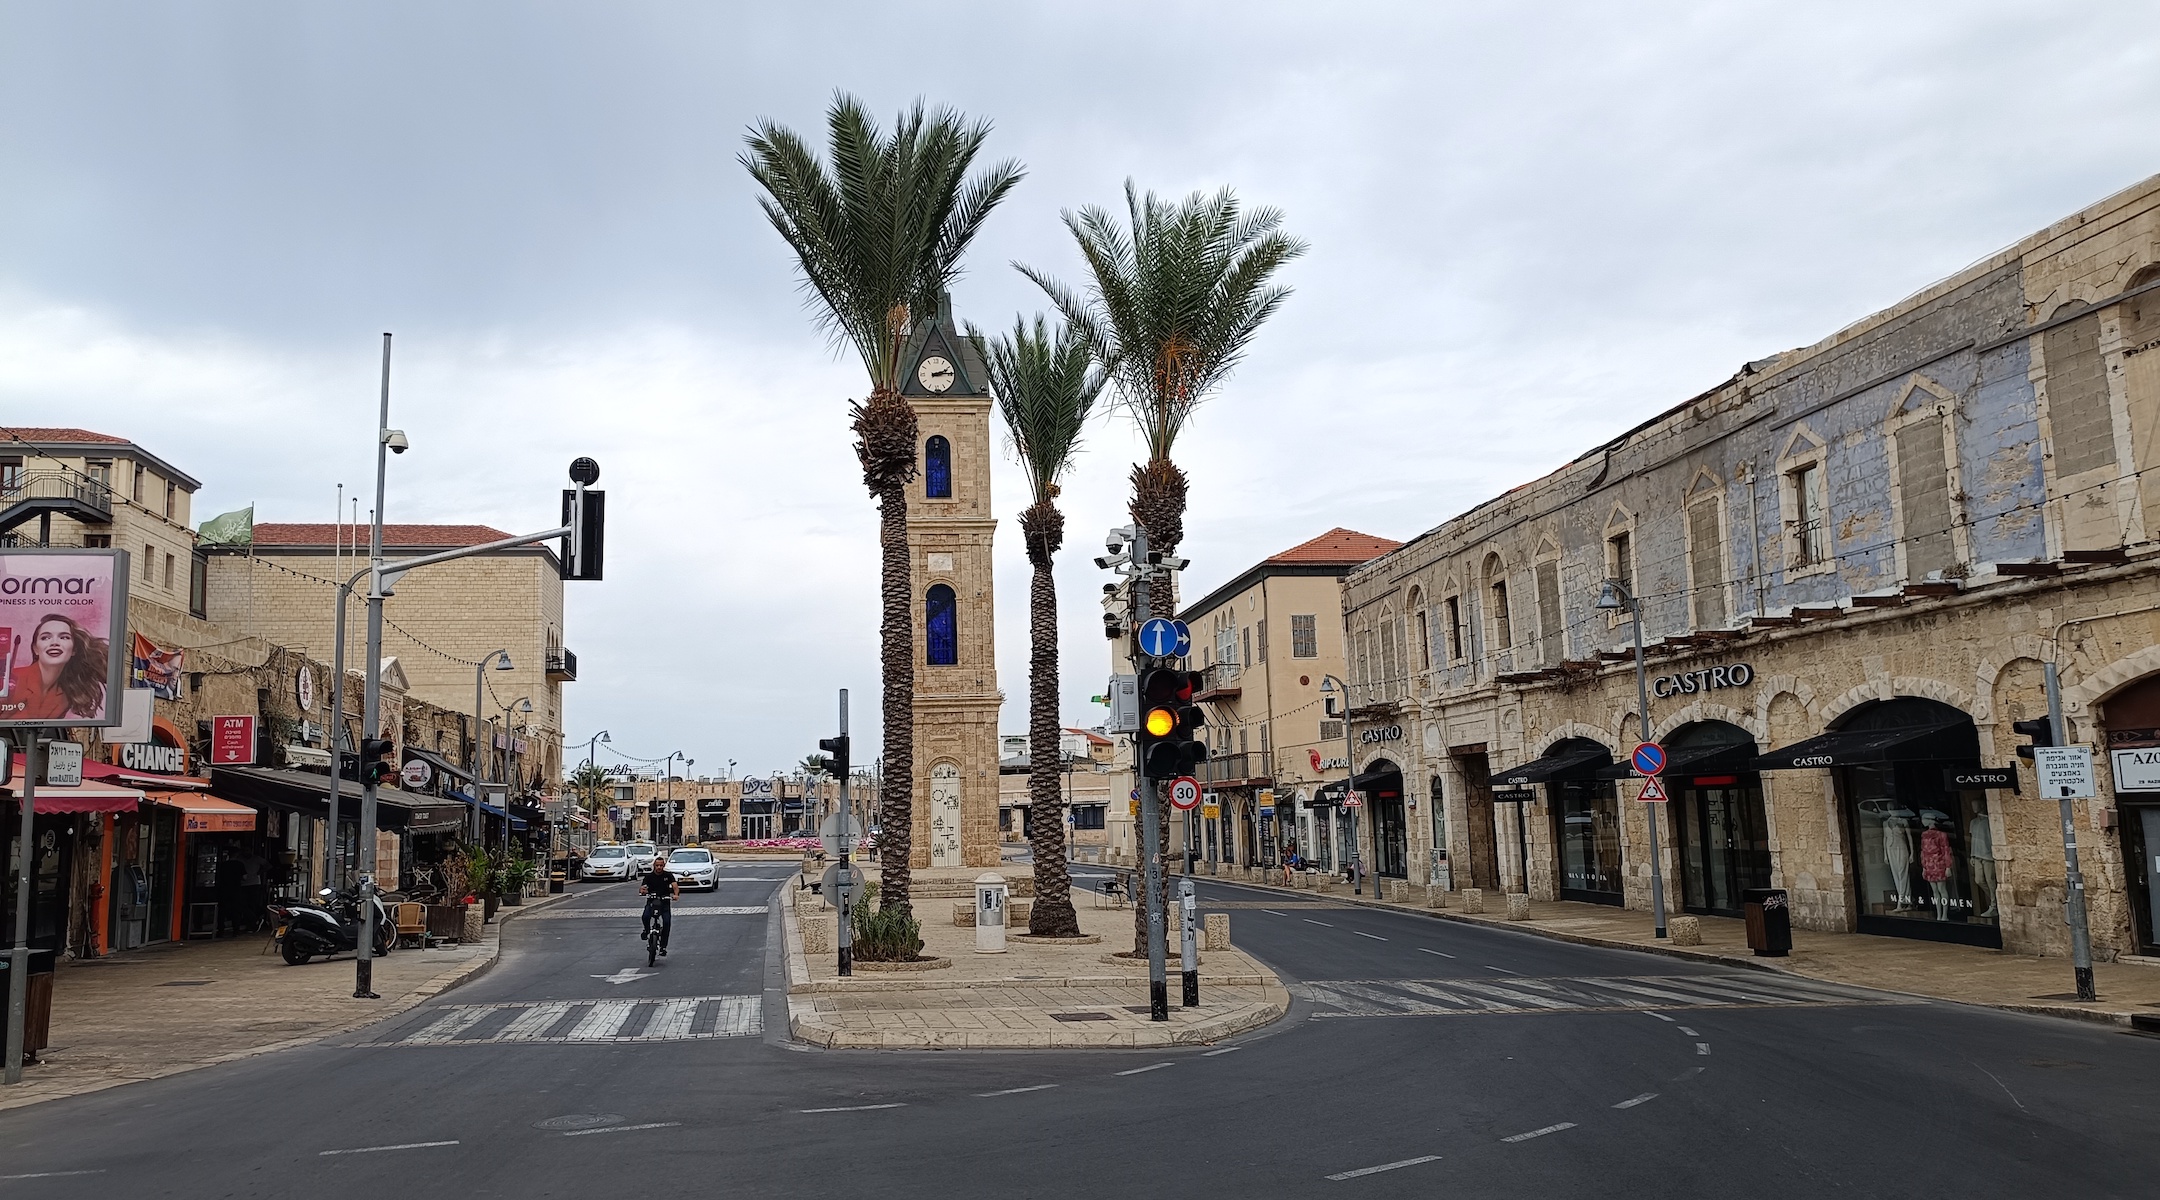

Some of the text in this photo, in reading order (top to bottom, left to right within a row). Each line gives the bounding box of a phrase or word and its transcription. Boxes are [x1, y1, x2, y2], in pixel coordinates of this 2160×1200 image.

[1652, 663, 1752, 698] CASTRO
[223, 719, 243, 728] ATM
[1360, 725, 1400, 743] CASTRO
[122, 742, 184, 771] CHANGE
[1793, 755, 1833, 767] CASTRO
[1320, 758, 1331, 769] RIP
[1508, 776, 1528, 784] CASTRO
[1956, 774, 2007, 783] CASTRO
[2048, 777, 2085, 785] אלקטרוניים
[1176, 787, 1194, 799] 30
[1890, 894, 1973, 908] MEN & WOMEN
